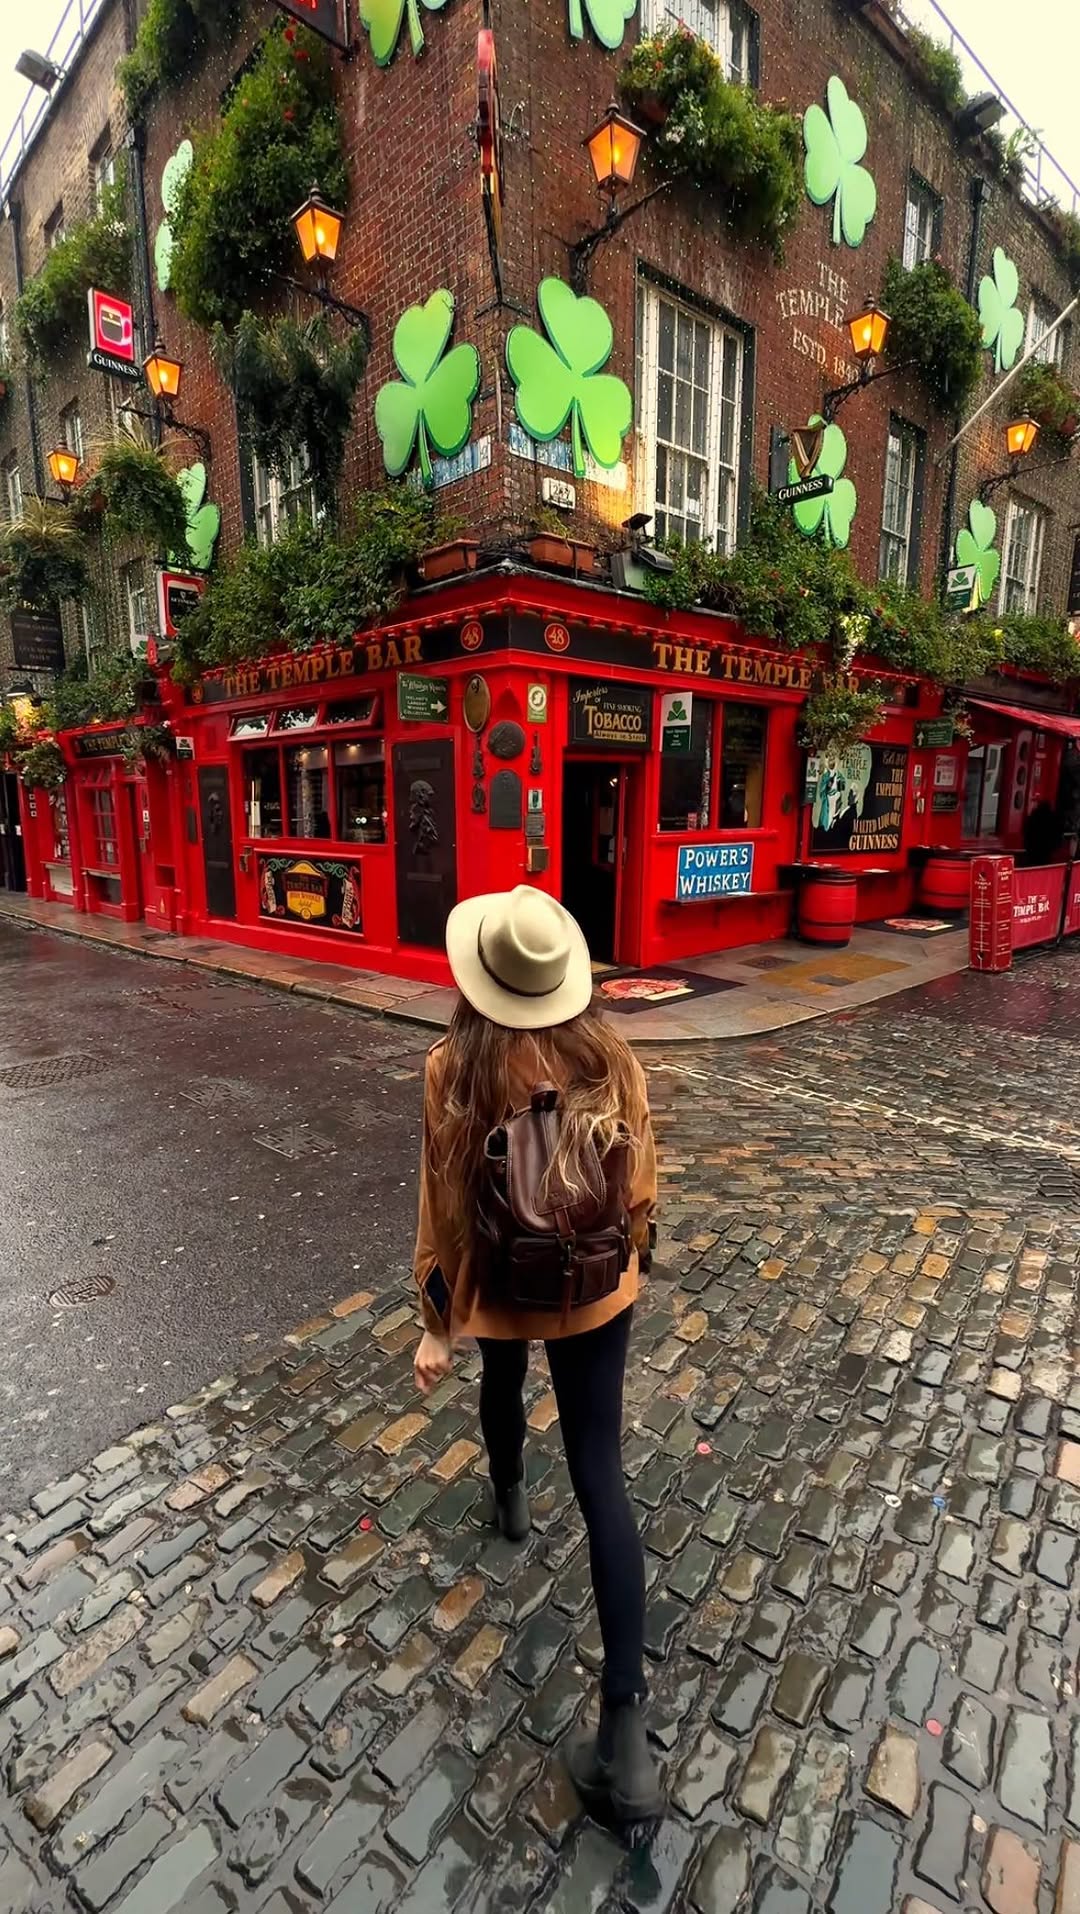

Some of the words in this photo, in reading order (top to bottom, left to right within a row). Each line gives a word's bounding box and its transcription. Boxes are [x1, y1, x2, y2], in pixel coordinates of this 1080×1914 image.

[817, 260, 850, 305] THE
[776, 288, 845, 333] TEMPLE
[93, 353, 139, 377] GUINNESS
[778, 479, 824, 501] GUINNESS
[464, 626, 481, 648] 48
[548, 627, 566, 646] 48
[223, 671, 261, 699] THE
[266, 649, 355, 689] TEMPLE
[366, 635, 424, 671] BAR
[653, 641, 712, 676] THE
[721, 653, 813, 690] TEMPLE
[583, 705, 642, 736] TOBACCO
[849, 834, 899, 851] GUINNESS
[684, 847, 749, 869] POWER'S
[680, 872, 750, 895] WHISKEY
